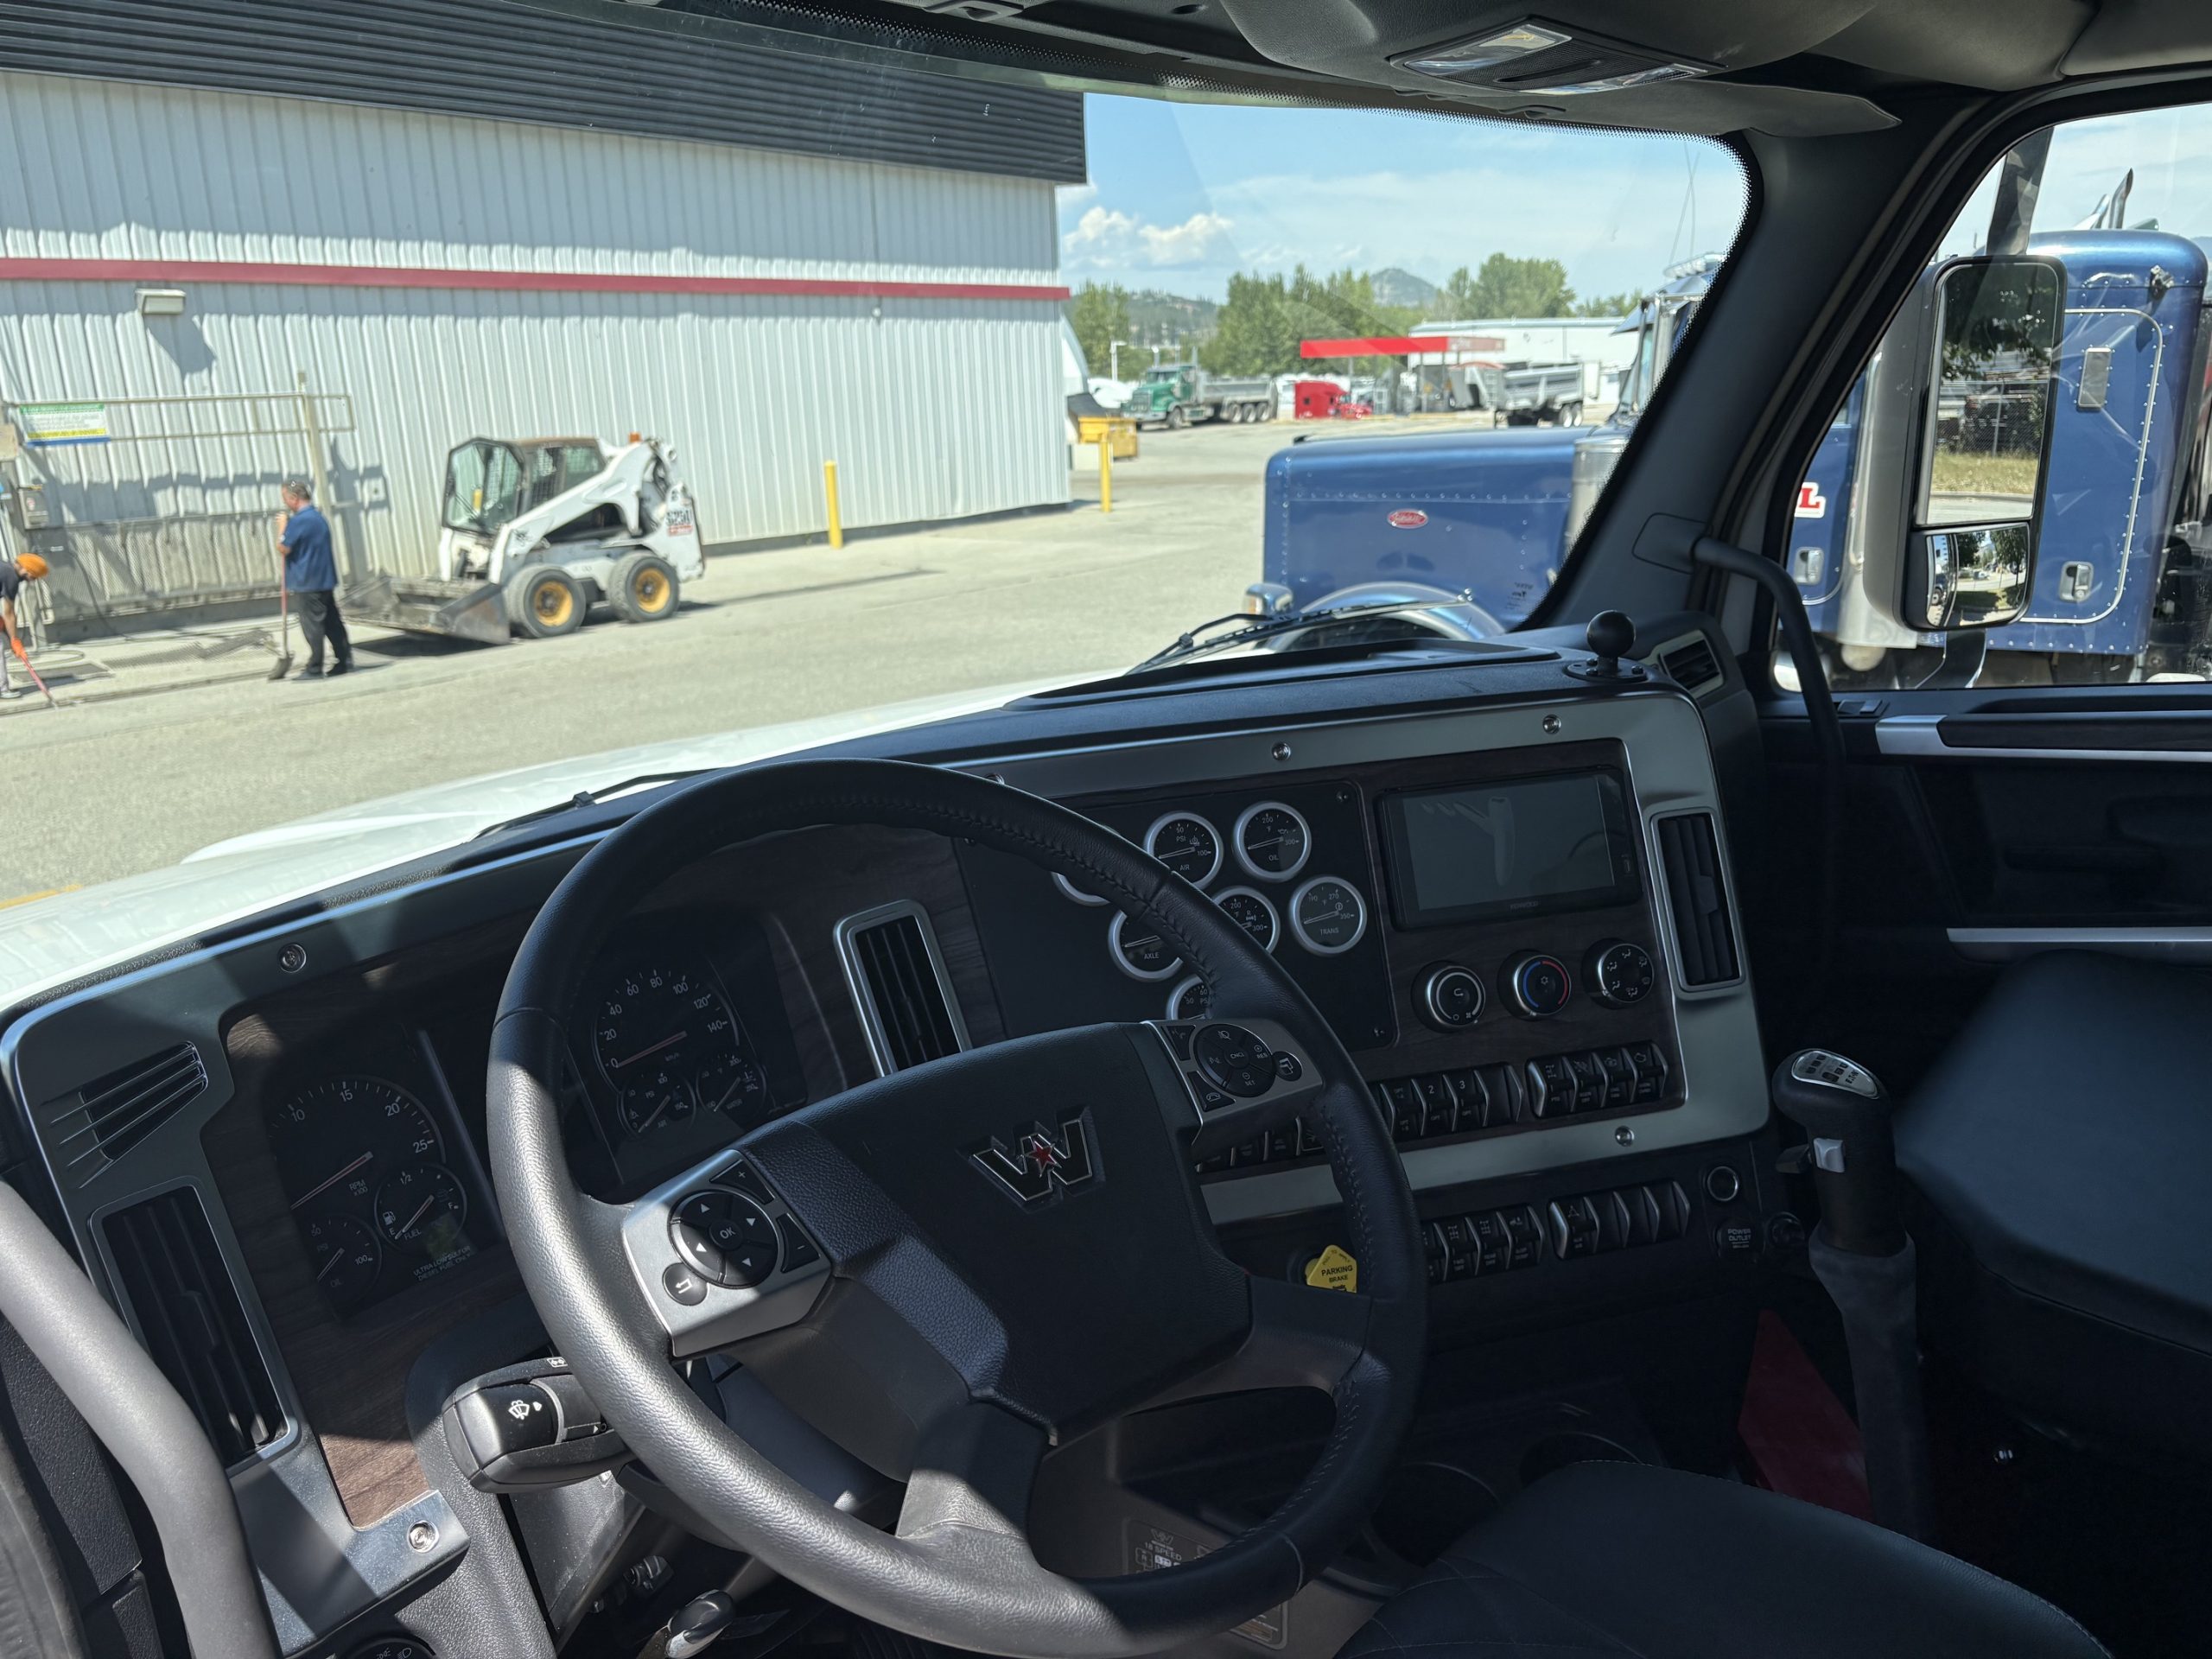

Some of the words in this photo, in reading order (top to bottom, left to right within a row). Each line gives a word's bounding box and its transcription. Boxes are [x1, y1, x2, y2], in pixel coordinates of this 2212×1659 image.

[1319, 927, 1339, 936] TRANS
[1143, 951, 1160, 960] AXLE
[650, 976, 663, 988] 80
[672, 982, 689, 995] 100
[626, 983, 639, 996] 60
[693, 996, 709, 1010] 120
[609, 1004, 622, 1016] 40
[706, 1020, 722, 1033] 140
[604, 1028, 617, 1041] 20
[610, 1058, 619, 1068] 0
[1427, 1084, 1434, 1095] 2
[1459, 1080, 1465, 1090] 3
[340, 1089, 353, 1102] 15
[290, 1109, 306, 1122] 10
[385, 1102, 400, 1117] 20
[412, 1139, 429, 1154] 25
[349, 1178, 366, 1192] RPM
[399, 1174, 413, 1185] 1/2
[389, 1227, 396, 1237] E
[404, 1228, 423, 1241] FUEL
[719, 1226, 737, 1240] OK
[354, 1254, 368, 1266] 100
[414, 1263, 433, 1276] ULTRA
[1321, 1264, 1354, 1277] PARKING
[1328, 1274, 1349, 1283] BRAKE
[1154, 1545, 1182, 1561] SPEED
